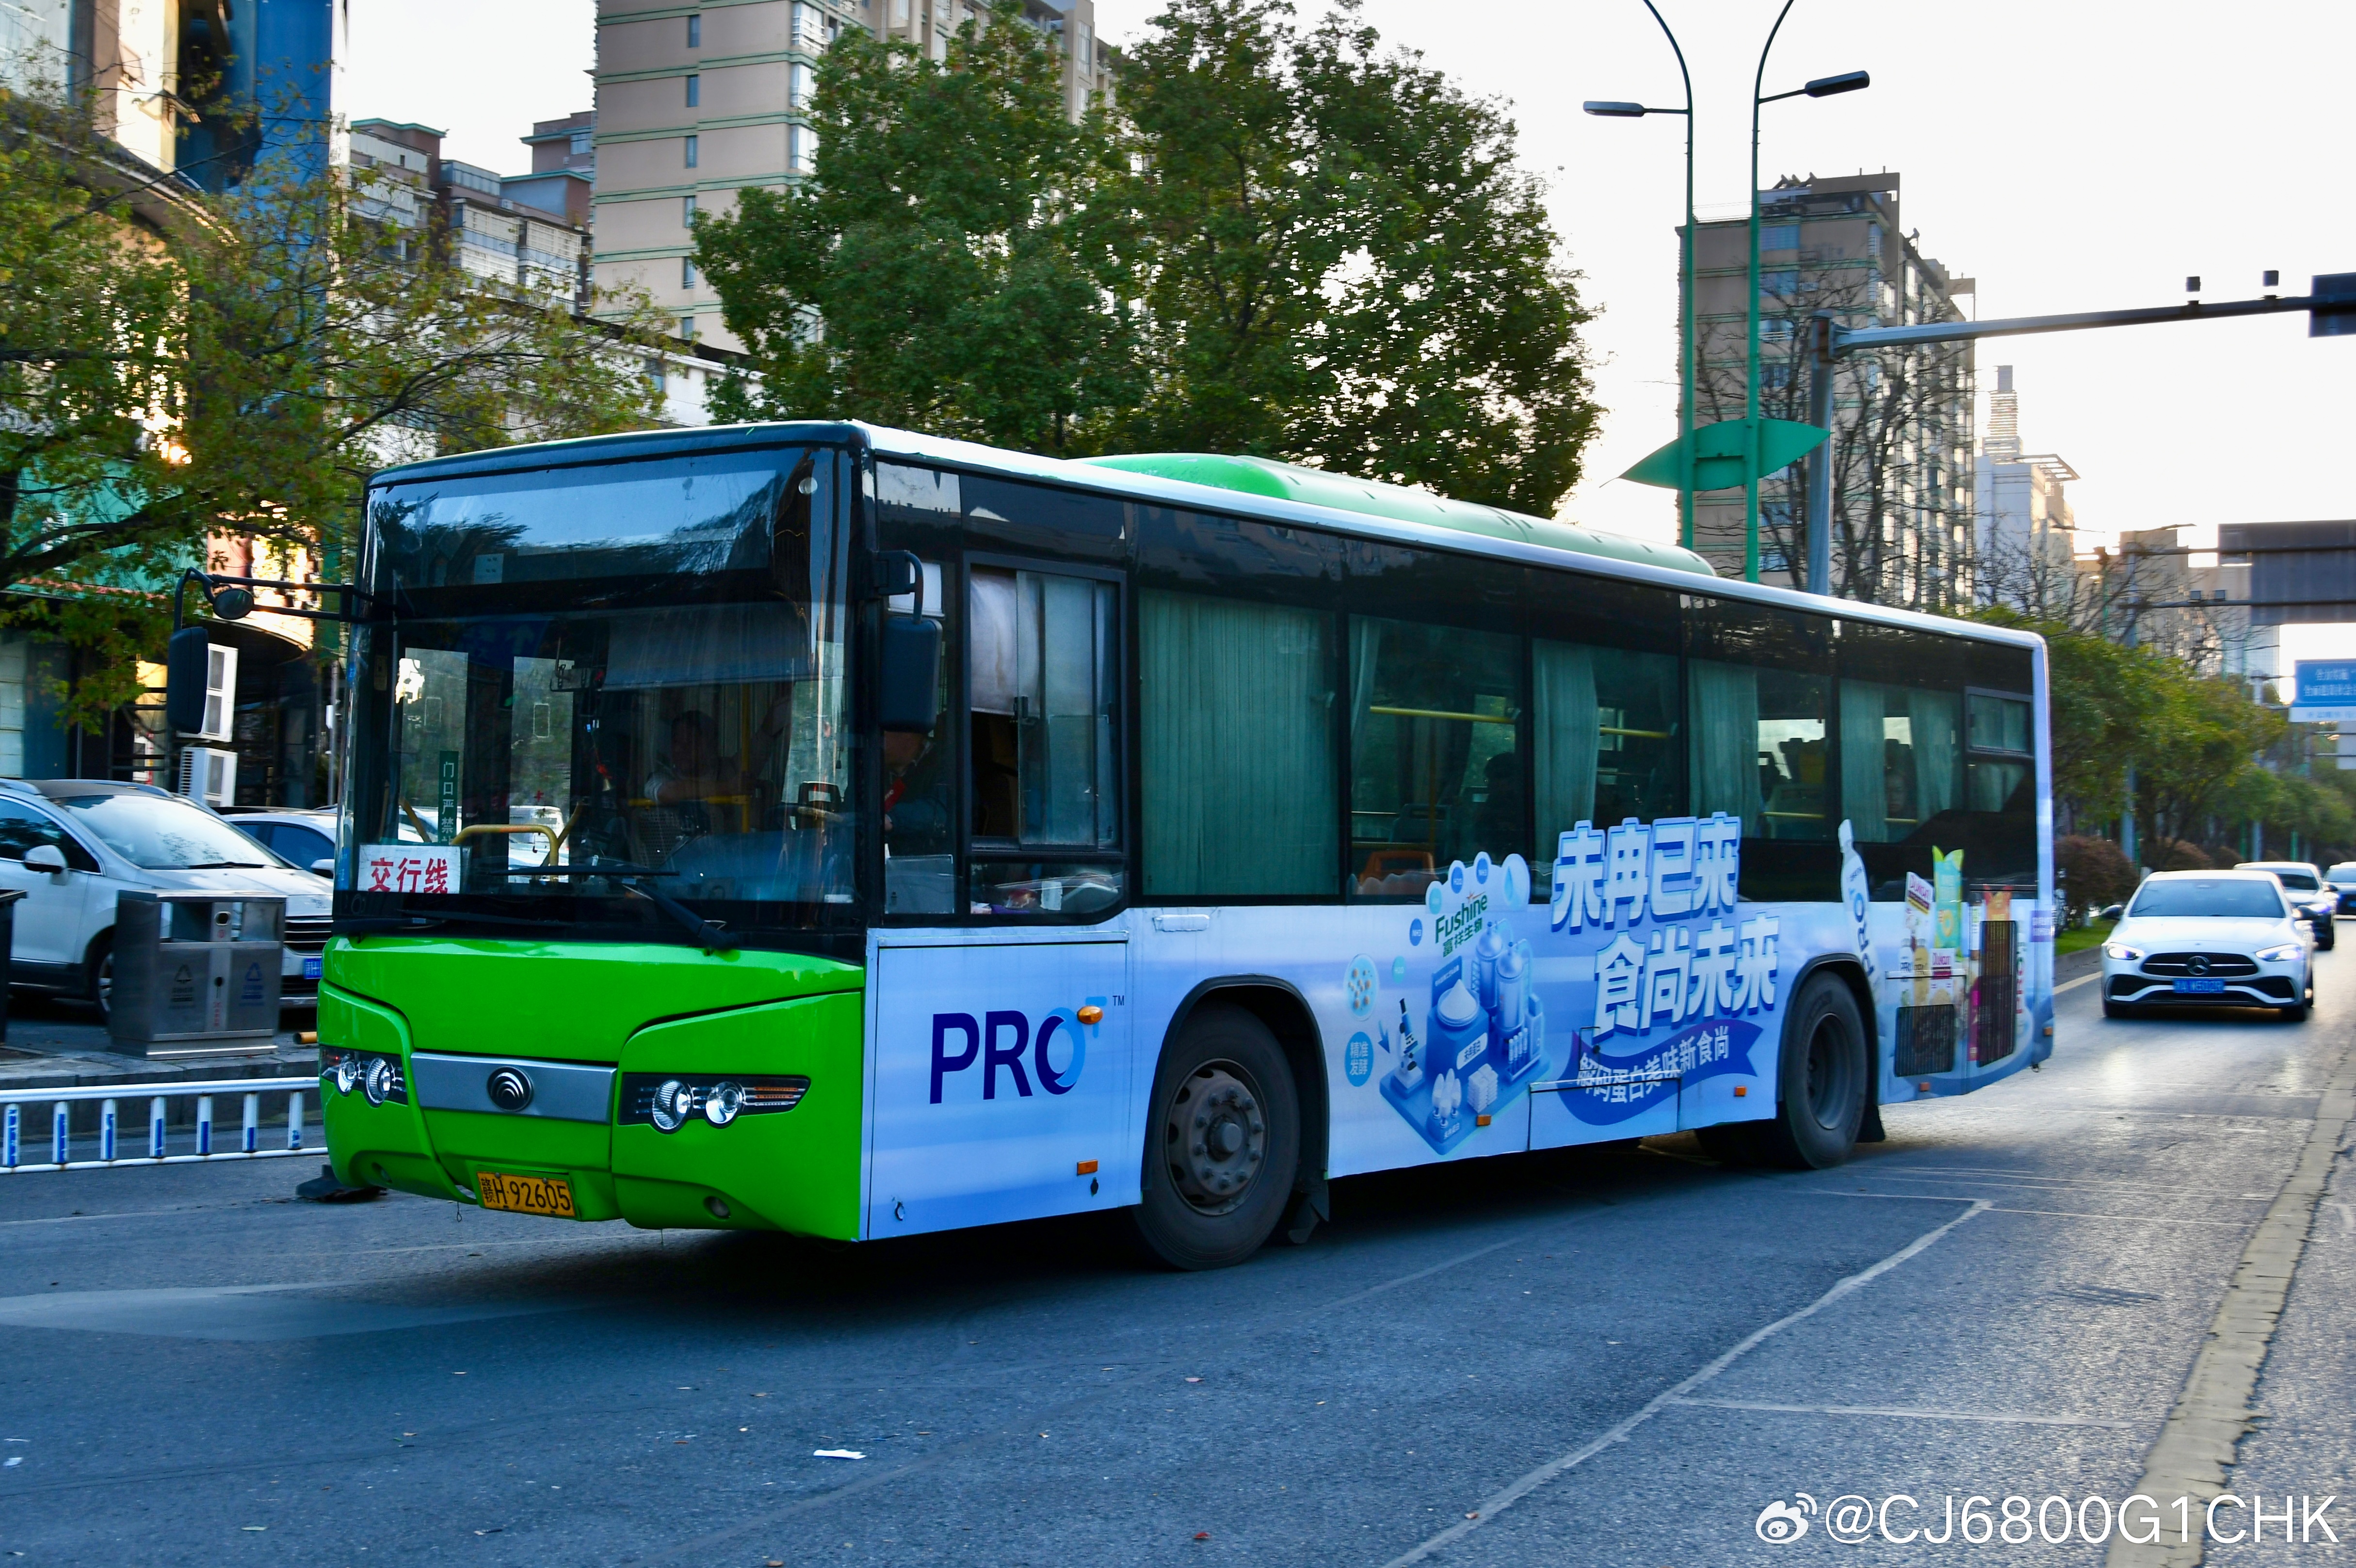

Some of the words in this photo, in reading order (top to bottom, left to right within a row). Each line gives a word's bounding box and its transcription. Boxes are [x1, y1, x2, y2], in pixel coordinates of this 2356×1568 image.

[368, 857, 448, 894] 交行线
[1436, 895, 1488, 944] Fushine
[1443, 917, 1483, 958] 富祥生物
[1593, 912, 1780, 1042] 食尚未来
[1577, 1026, 1729, 1104] 解码蛋白美味新食尚
